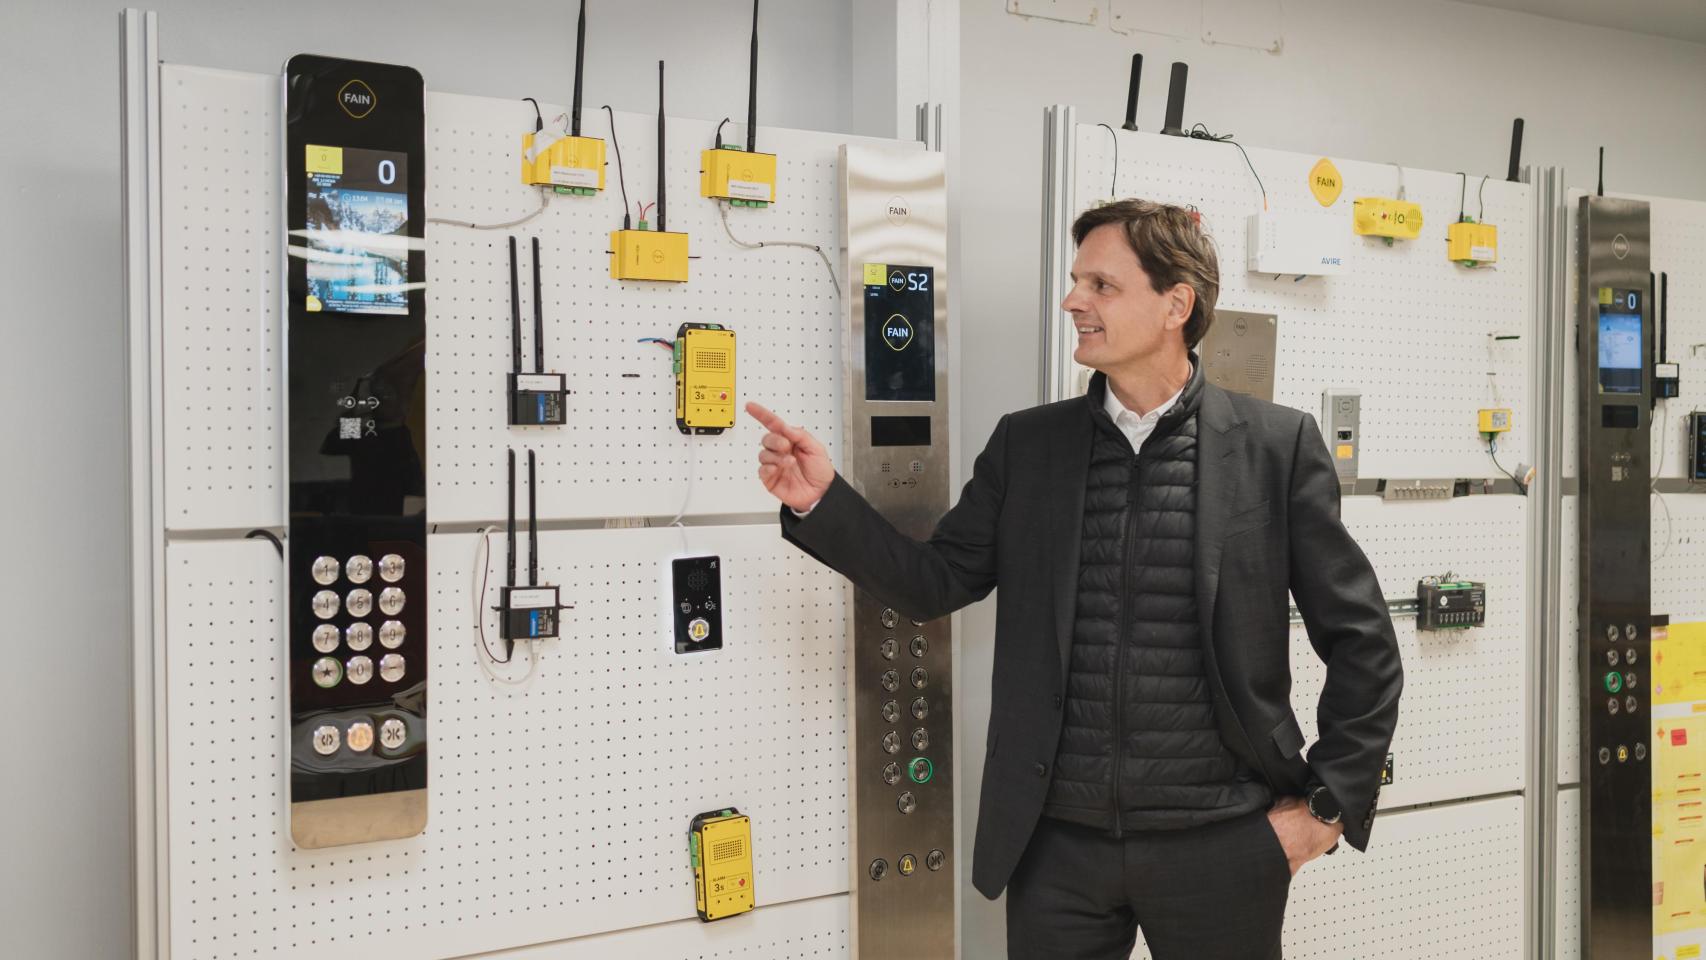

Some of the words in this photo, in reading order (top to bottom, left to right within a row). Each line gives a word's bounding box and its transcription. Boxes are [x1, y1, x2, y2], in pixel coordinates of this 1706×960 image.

[344, 93, 370, 105] FAIN
[378, 159, 396, 185] 0
[1317, 176, 1336, 187] FAIN
[889, 206, 907, 215] FAIN
[1321, 257, 1341, 266] AVIRE
[907, 272, 928, 291] S2
[1627, 292, 1637, 310] 0
[887, 327, 909, 337] FAIN
[356, 562, 363, 576] 2
[389, 561, 396, 575] 3
[356, 596, 364, 610] 5
[389, 595, 396, 608] 6
[324, 631, 330, 645] 7
[357, 630, 364, 643] 8
[390, 628, 396, 641] 9
[356, 663, 364, 676] 0
